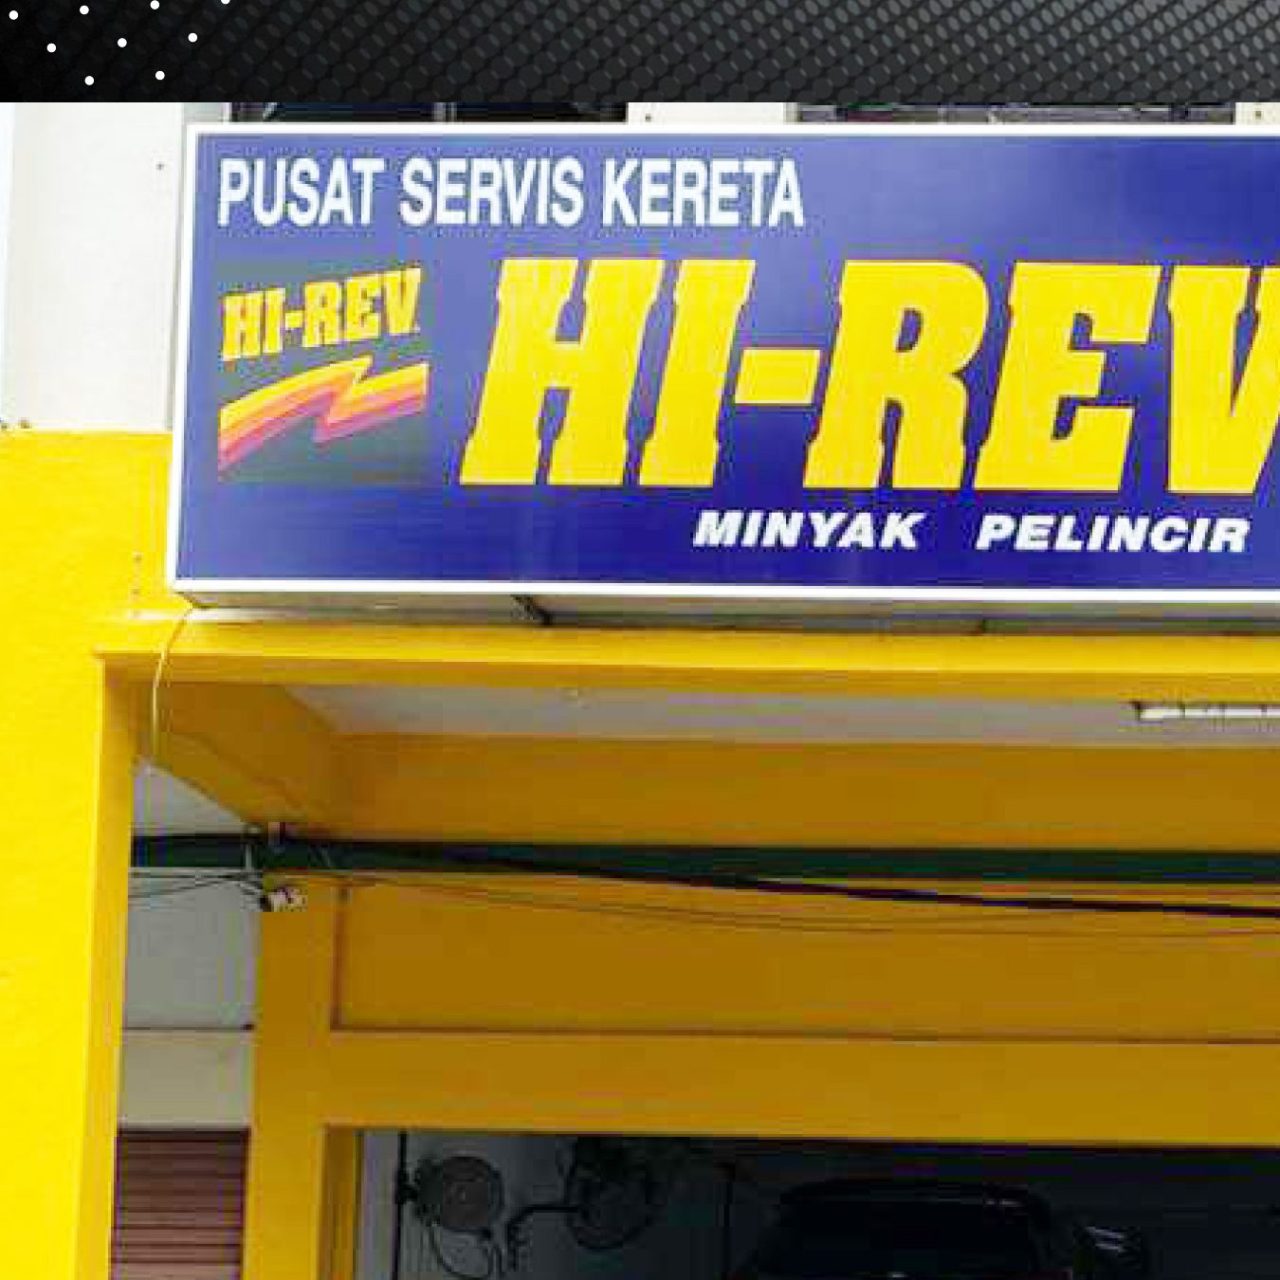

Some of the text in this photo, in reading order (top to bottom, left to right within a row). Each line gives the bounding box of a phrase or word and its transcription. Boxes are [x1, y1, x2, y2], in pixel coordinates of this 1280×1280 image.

[217, 157, 805, 228] PUSAT SERVIS KERETA
[221, 267, 421, 362] HI-REV
[693, 510, 1252, 553] MINYAK PELINCIR
